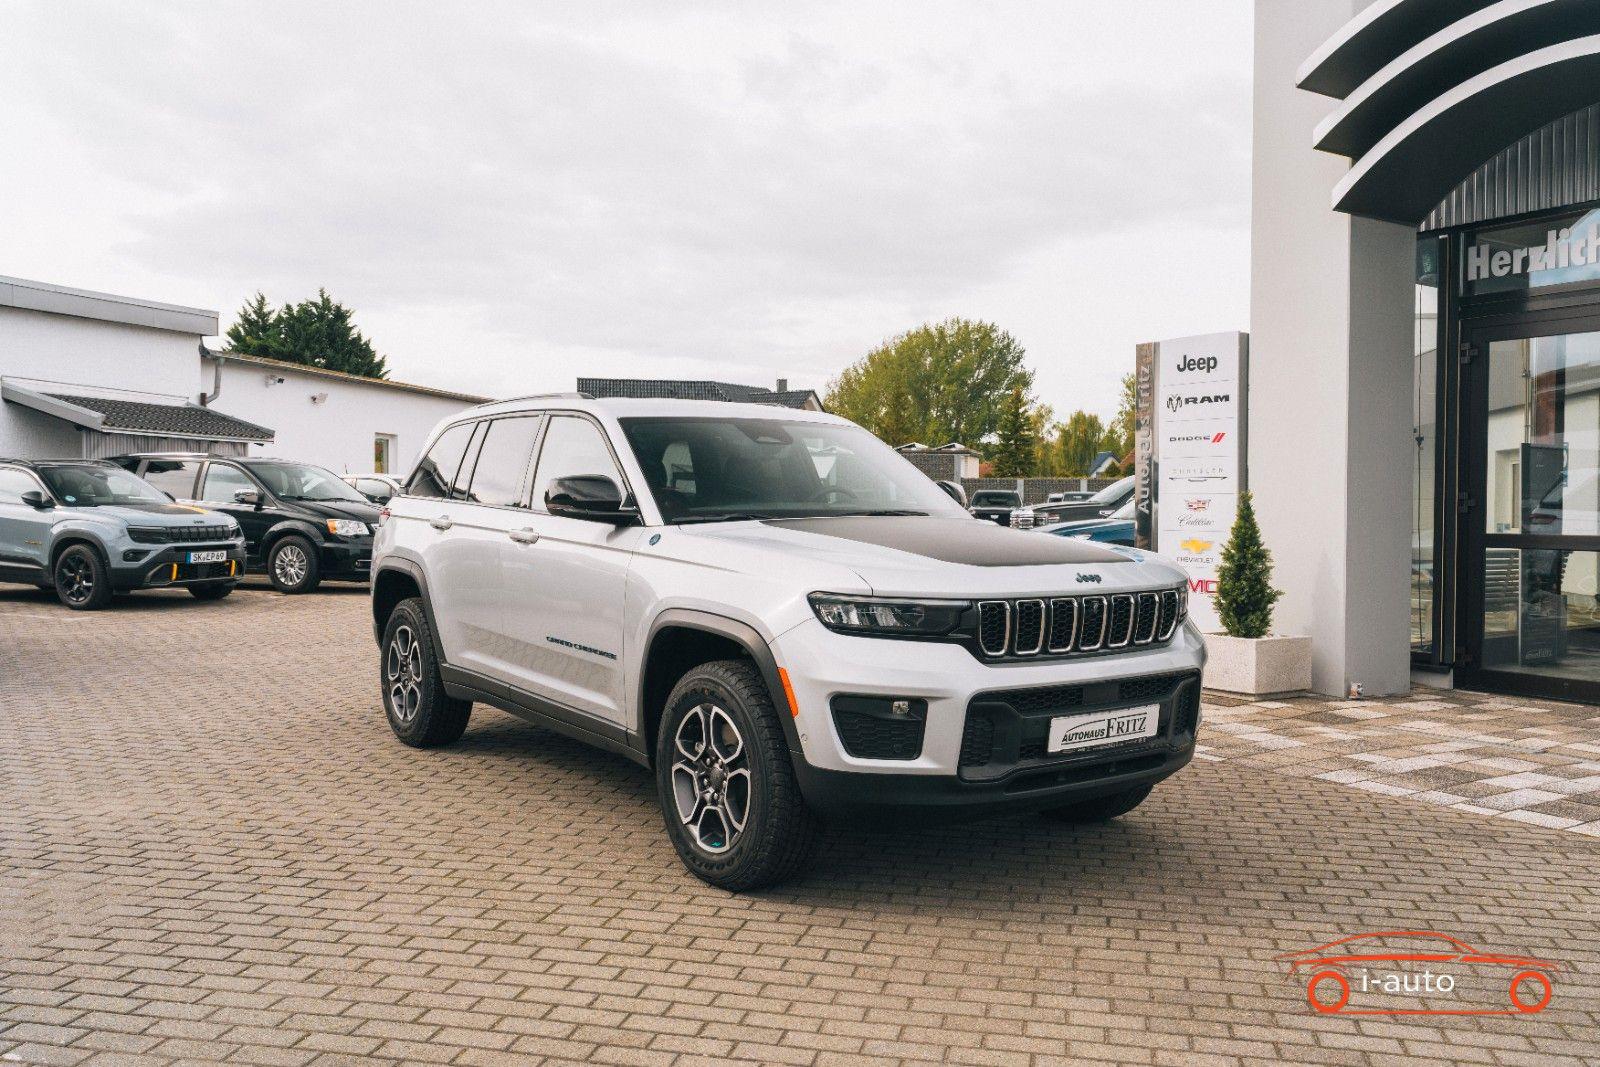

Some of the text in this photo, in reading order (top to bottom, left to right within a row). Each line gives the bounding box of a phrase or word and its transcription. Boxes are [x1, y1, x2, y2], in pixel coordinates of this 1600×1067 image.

[1177, 355, 1218, 373] Jeep
[1184, 394, 1230, 405] RAM
[1176, 556, 1214, 564] CHEVROLET
[1076, 573, 1102, 584] Jeep
[1188, 579, 1220, 594] MC
[1062, 717, 1147, 743] AUTOHAUS FRITZ
